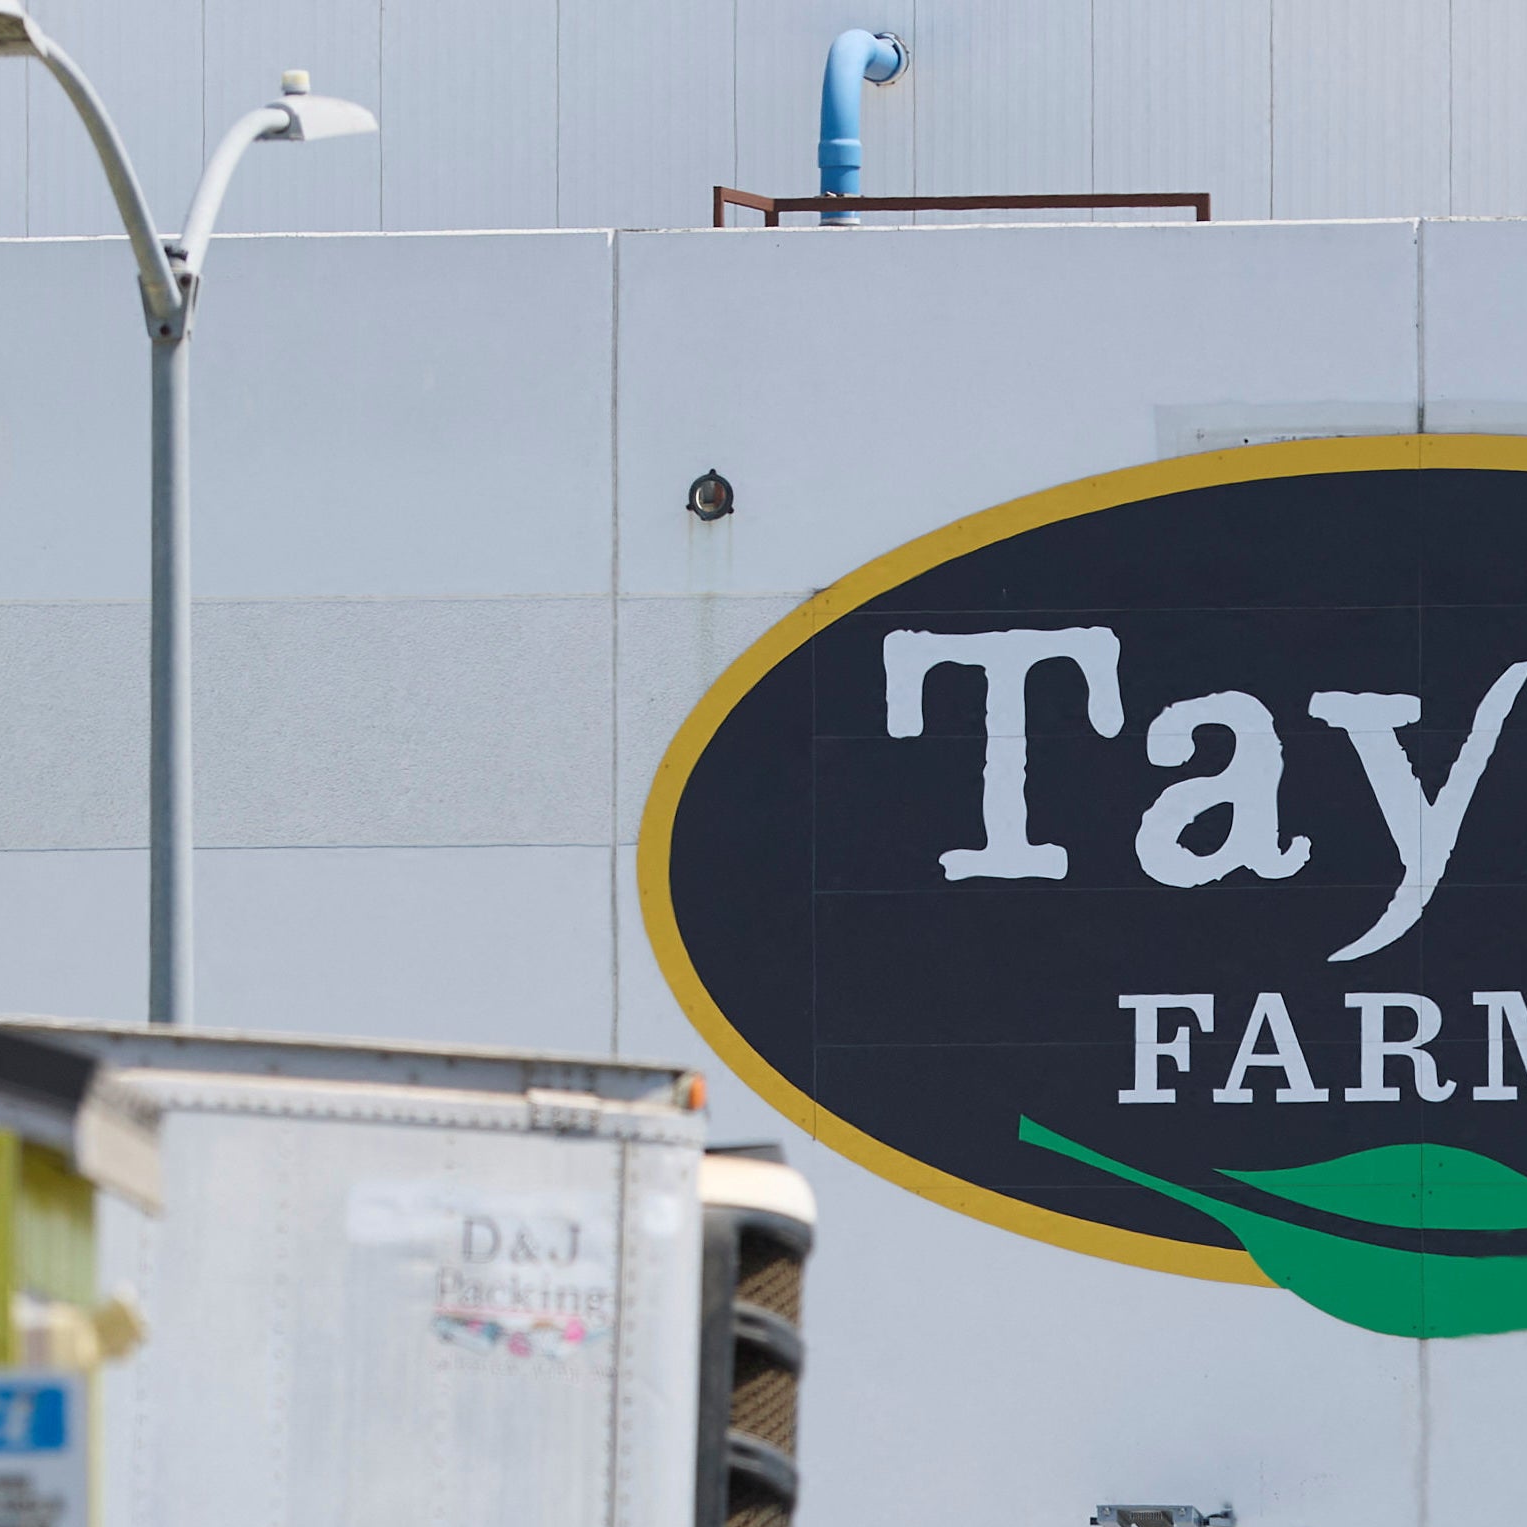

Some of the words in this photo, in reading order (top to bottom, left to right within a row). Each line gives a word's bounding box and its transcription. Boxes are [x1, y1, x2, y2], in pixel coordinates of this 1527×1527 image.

[462, 1215, 501, 1264] D
[509, 1224, 539, 1265] &
[547, 1219, 583, 1268] J
[435, 1266, 611, 1320] Packing
